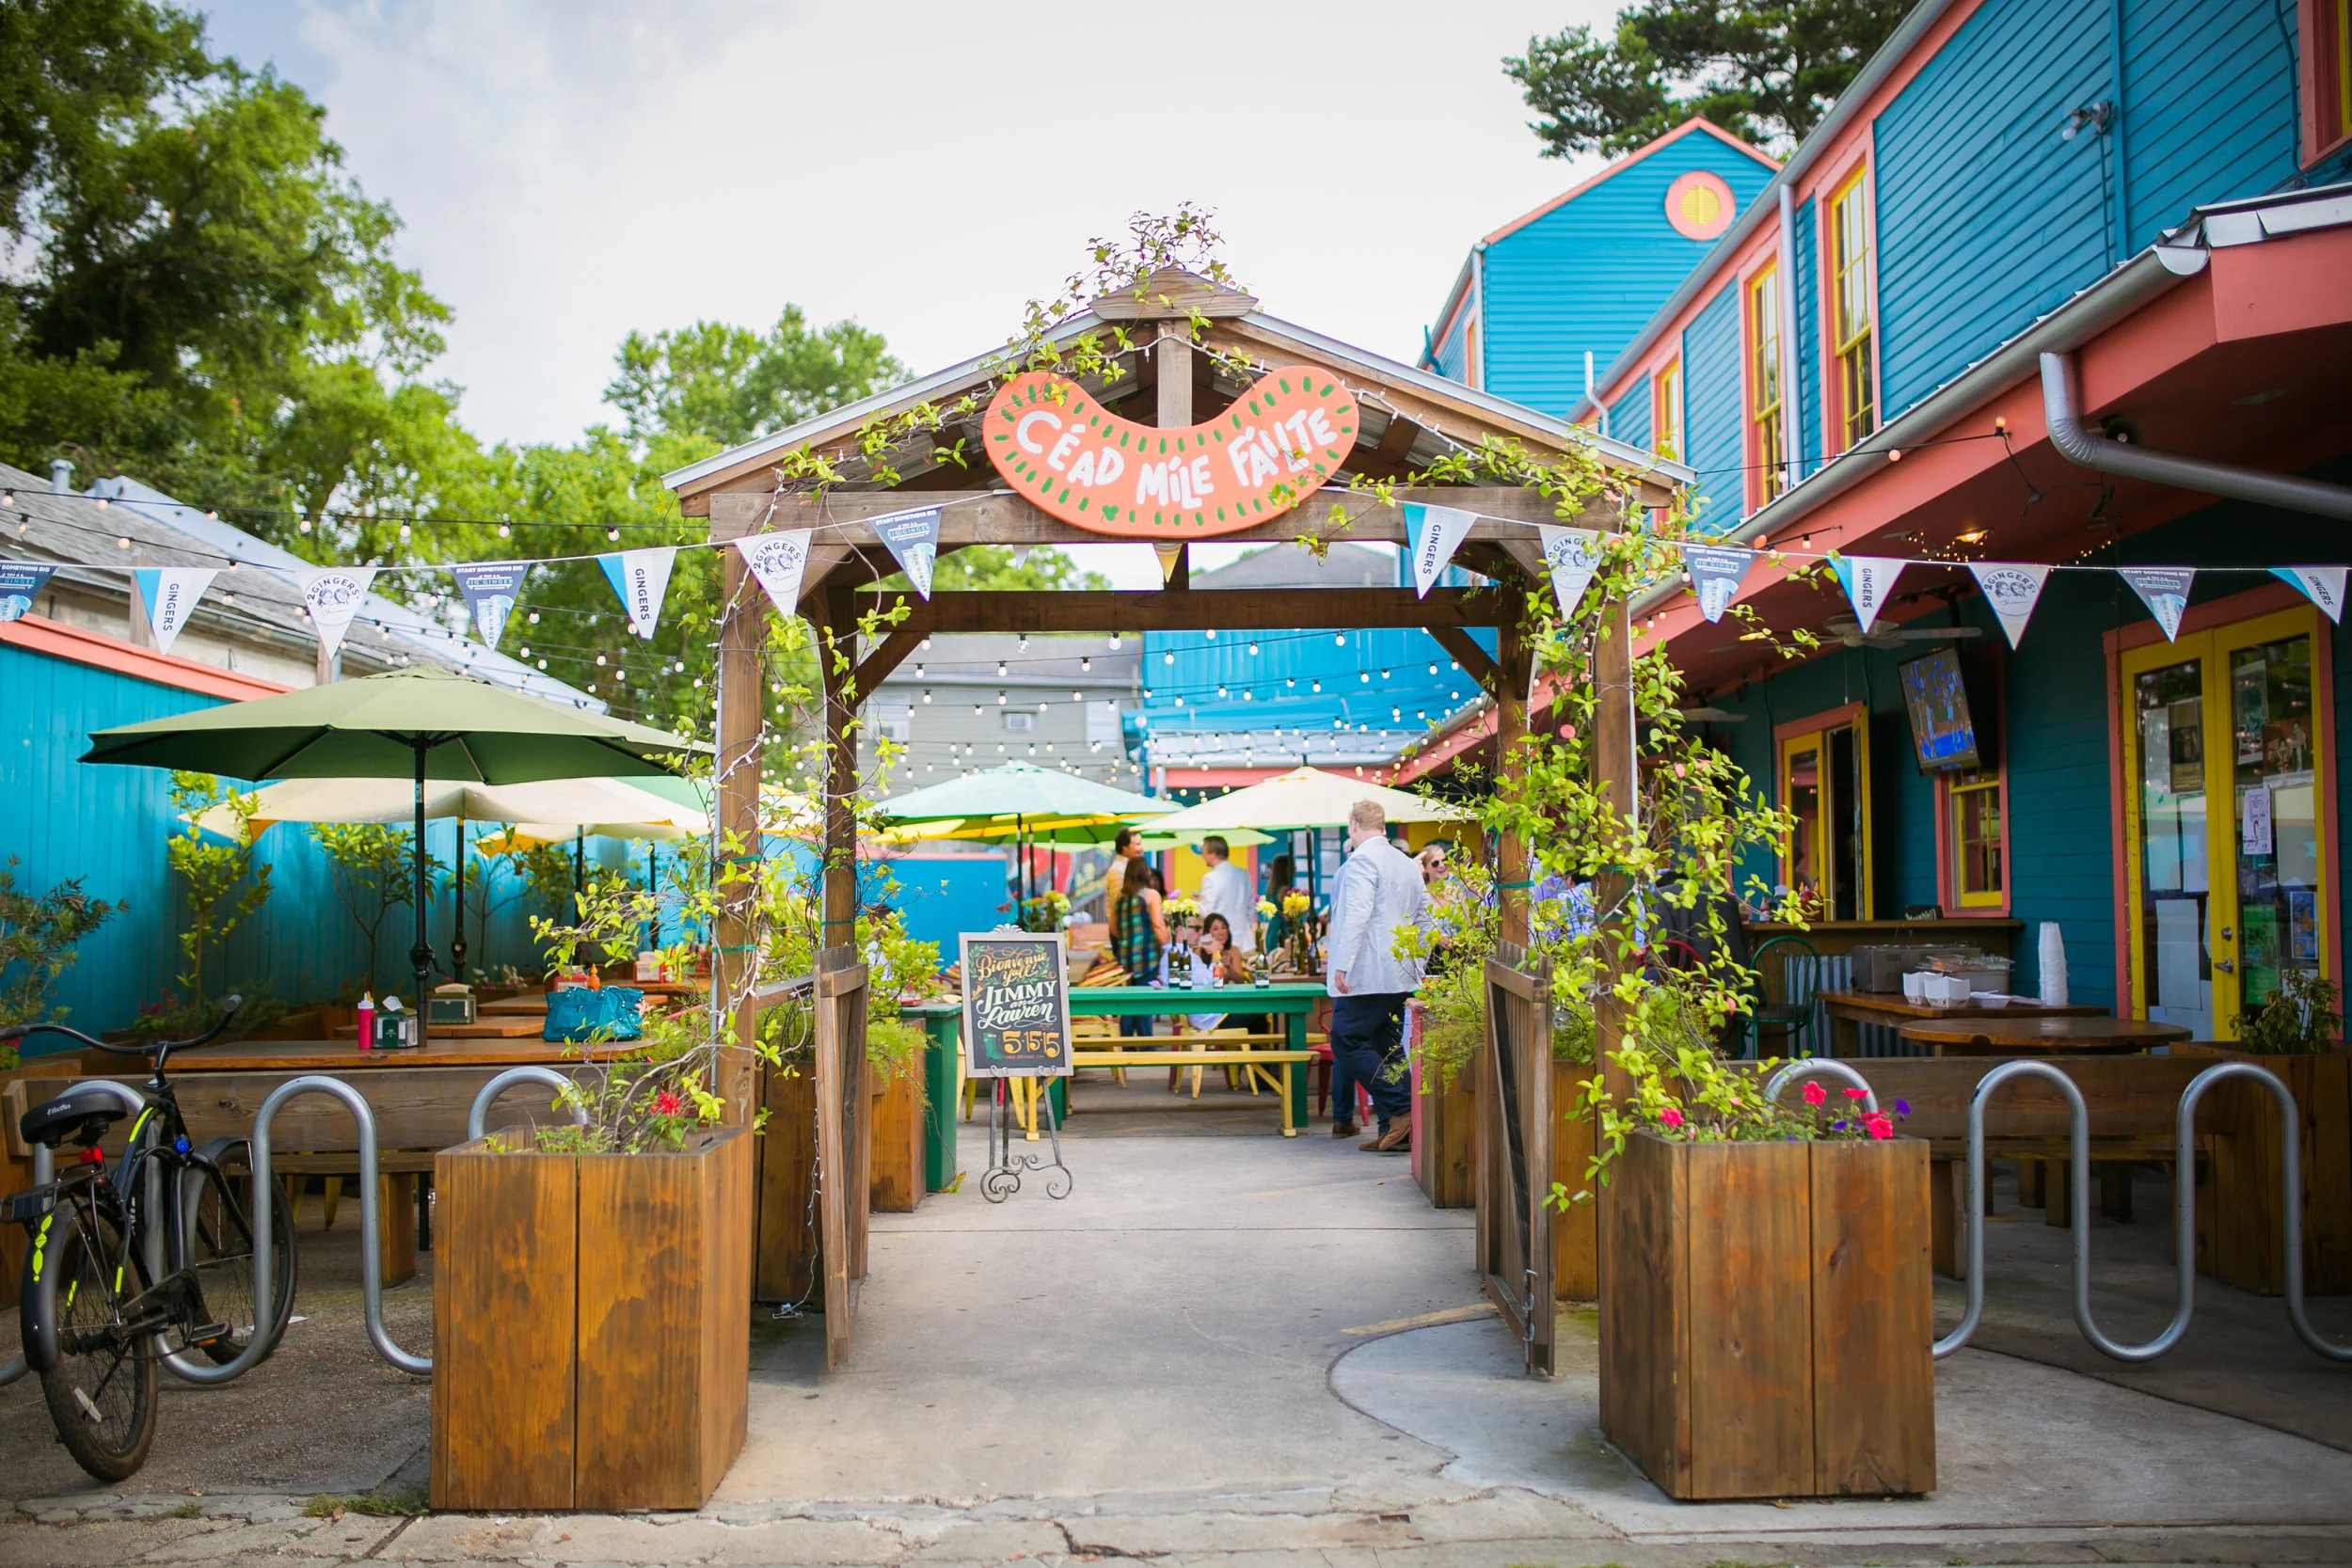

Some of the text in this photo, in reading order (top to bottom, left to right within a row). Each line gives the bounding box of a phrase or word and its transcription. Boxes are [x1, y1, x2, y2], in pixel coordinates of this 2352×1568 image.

[1016, 410, 1124, 487] CÉAD
[1228, 406, 1339, 487] FÁILTE
[875, 517, 894, 526] START
[895, 513, 927, 522] SOMETHING
[902, 526, 931, 535] GINGER
[1422, 524, 1441, 575] GINGERS
[635, 568, 650, 621] GINGERS
[1862, 567, 1873, 609] GINGERS
[2308, 576, 2334, 606] GINGERS
[163, 583, 180, 631] GINGERS
[976, 950, 1047, 981] Bienvenue
[976, 980, 1057, 1015] JIMMY
[1009, 996, 1043, 1009] and
[977, 1002, 1057, 1030] Lauren
